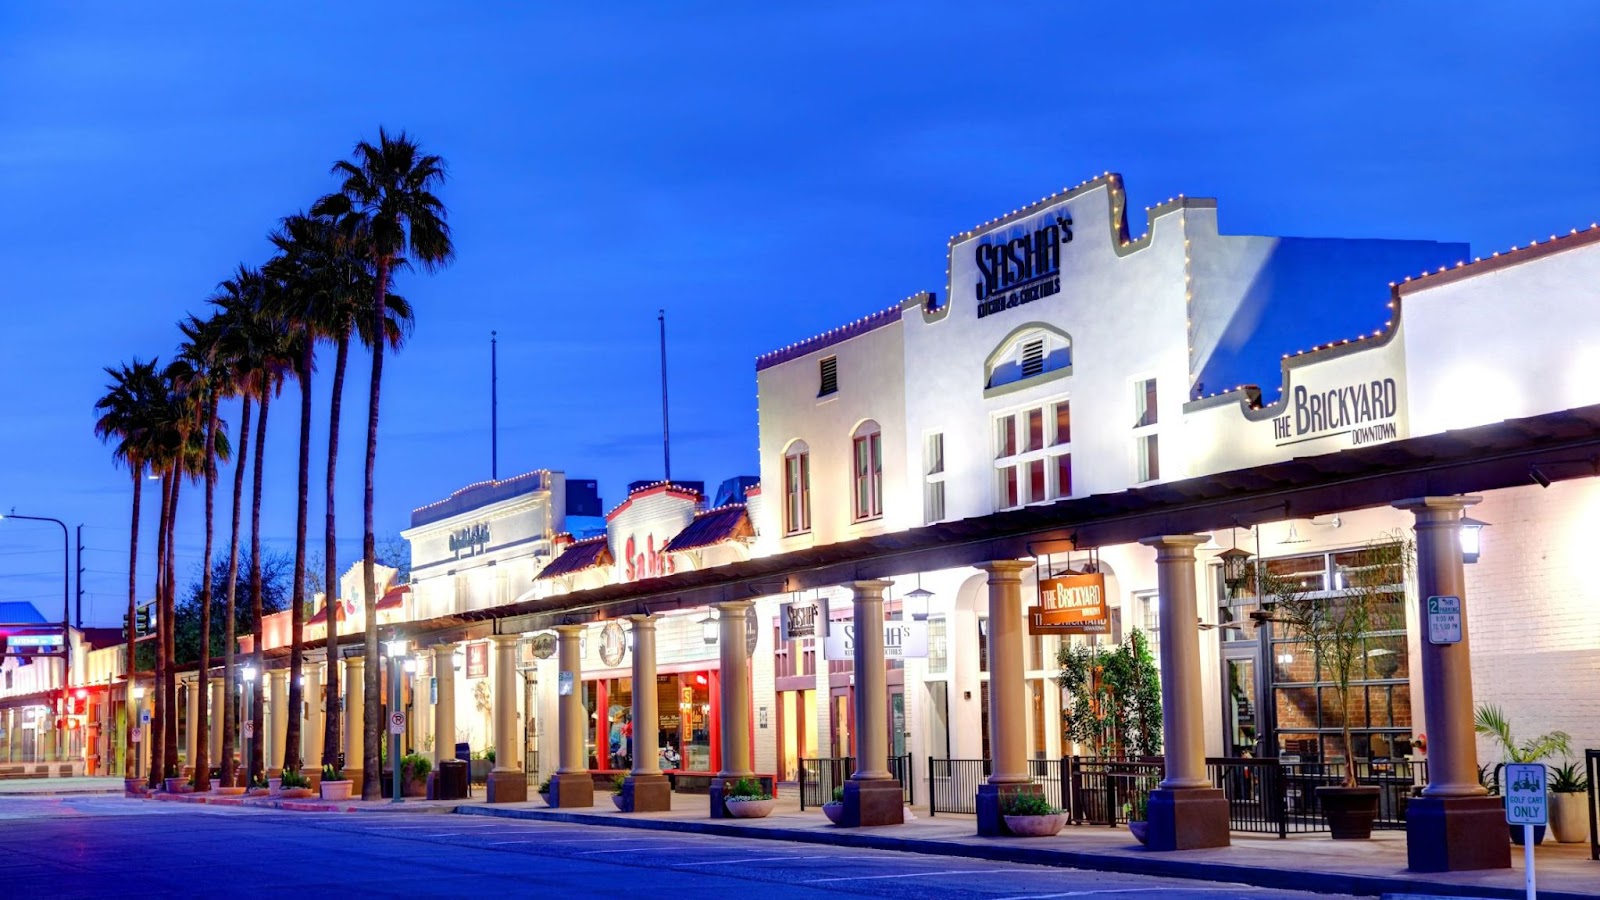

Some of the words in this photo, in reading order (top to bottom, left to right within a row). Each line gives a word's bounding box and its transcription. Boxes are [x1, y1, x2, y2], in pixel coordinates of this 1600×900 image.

[1006, 293, 1020, 309] &
[1273, 415, 1292, 440] THE
[1352, 422, 1397, 445] DOWNTOWN
[1042, 589, 1057, 610] THE
[1430, 600, 1437, 613] 2
[1527, 796, 1543, 804] CART
[1514, 806, 1539, 817] ONLY
